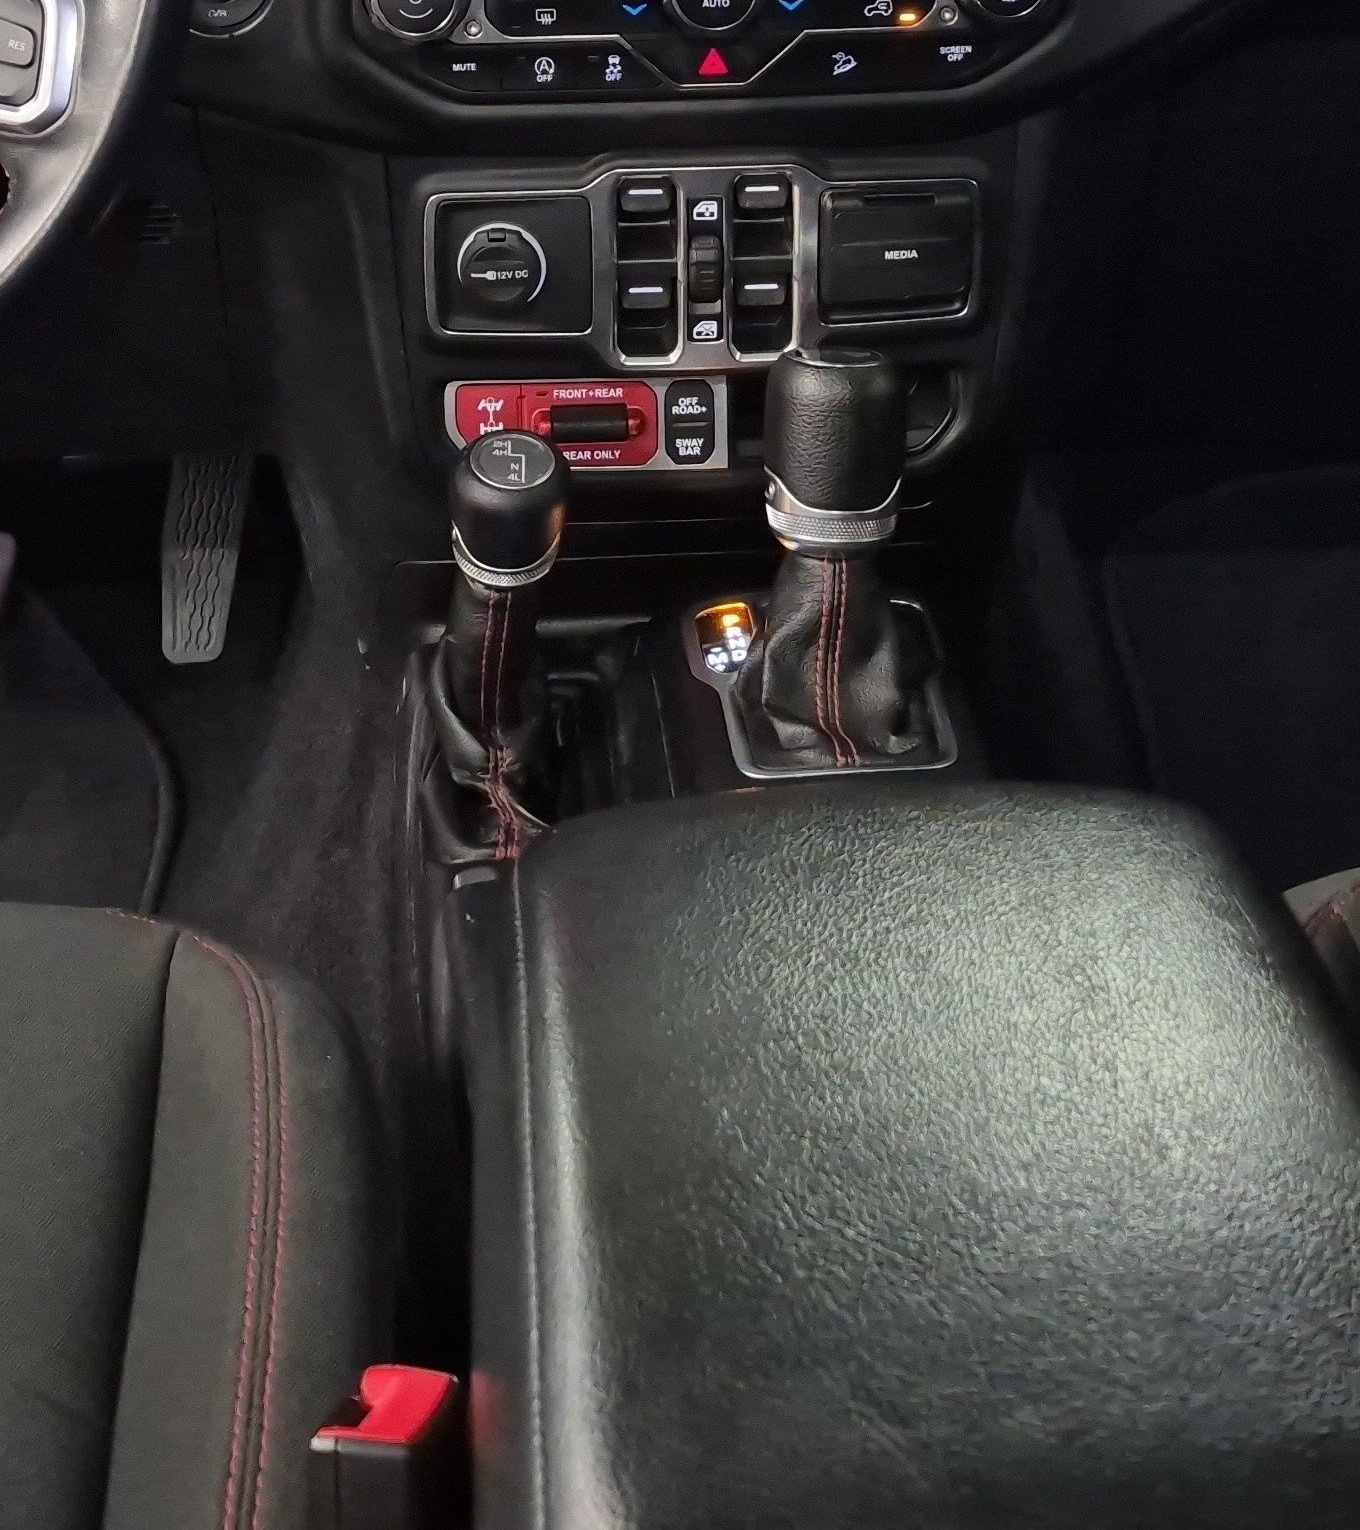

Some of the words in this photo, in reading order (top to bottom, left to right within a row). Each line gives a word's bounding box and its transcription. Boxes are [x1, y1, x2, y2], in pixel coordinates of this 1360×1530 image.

[8, 39, 26, 51] RES
[940, 45, 972, 54] SCREEN
[947, 54, 964, 62] OFF
[452, 62, 477, 72] MUTE
[536, 74, 553, 82] OFF
[605, 73, 622, 81] OFF
[884, 248, 919, 260] MEDIA
[497, 269, 514, 280] 12V
[515, 269, 529, 280] DC
[678, 397, 699, 407] OFF
[675, 438, 704, 448] SWAY
[563, 451, 591, 461] REAR
[594, 450, 621, 460] ONLY
[679, 446, 701, 456] BAR
[510, 462, 520, 471] N
